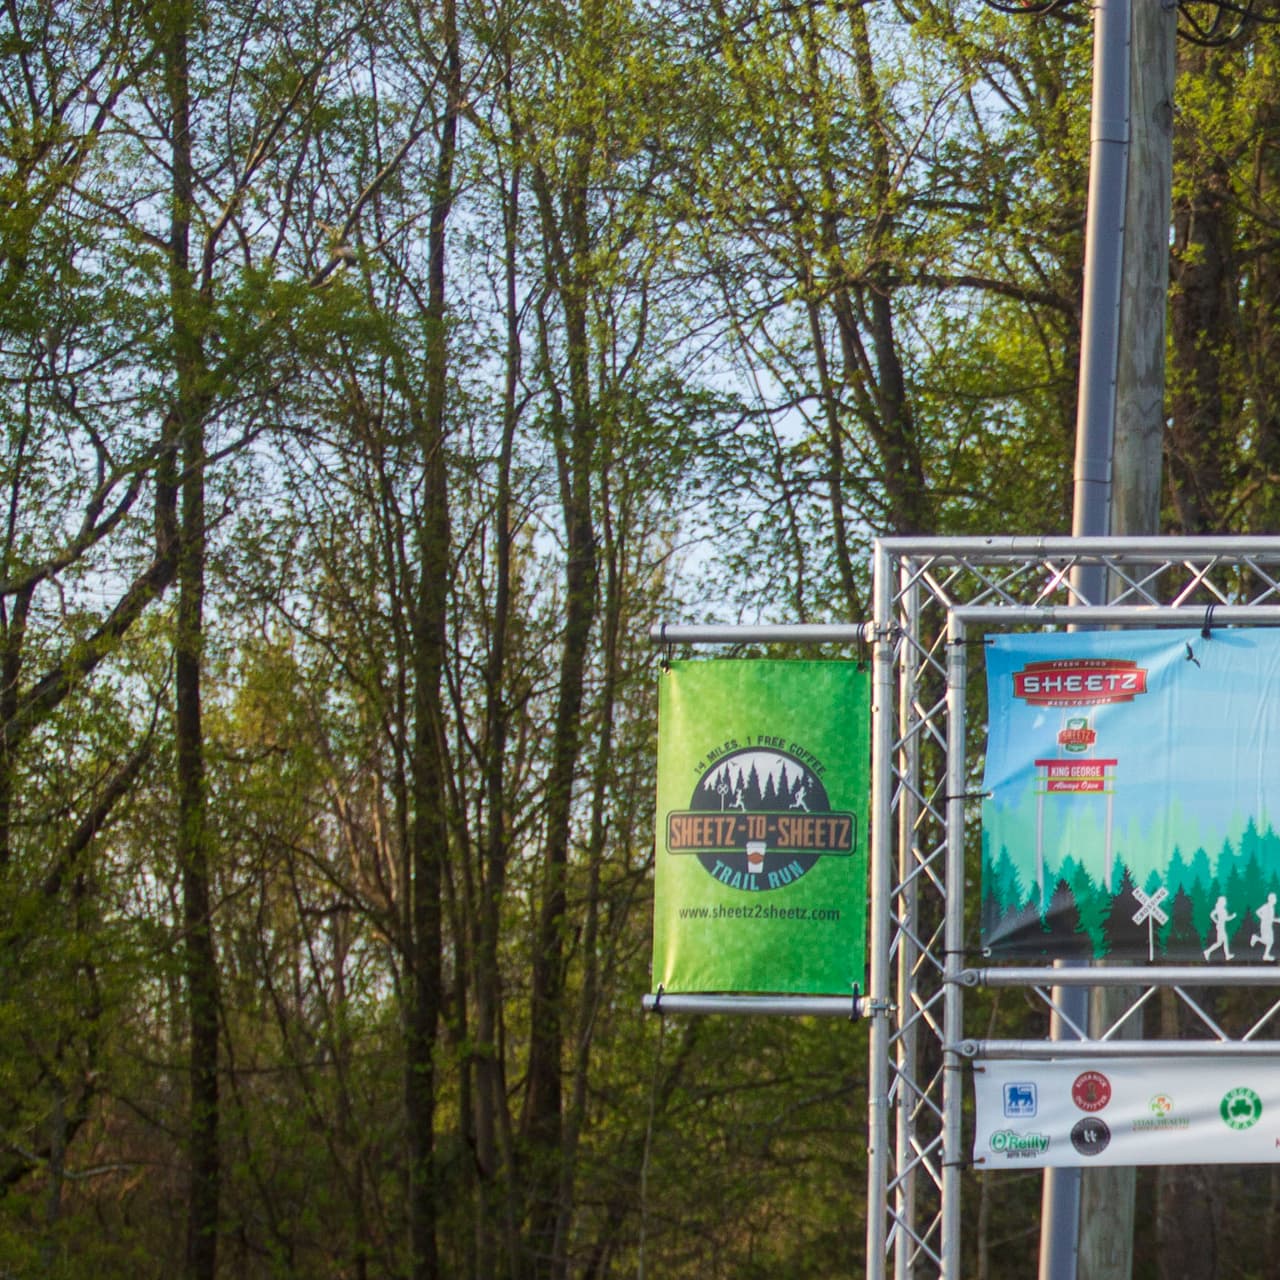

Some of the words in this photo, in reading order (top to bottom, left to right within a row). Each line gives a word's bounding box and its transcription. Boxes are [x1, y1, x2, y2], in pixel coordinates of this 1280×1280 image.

[1023, 673, 1138, 694] SHEETZ
[757, 735, 786, 748] FREE
[1051, 766, 1070, 777] KING
[1070, 766, 1101, 777] GEORGE
[1052, 781, 1080, 792] Always
[1080, 780, 1100, 791] Open
[710, 859, 760, 891] TRAIL
[767, 859, 805, 889] RUN
[678, 904, 842, 921] www.sheetz2sheetz.com
[991, 1129, 1049, 1153] O'Reilly
